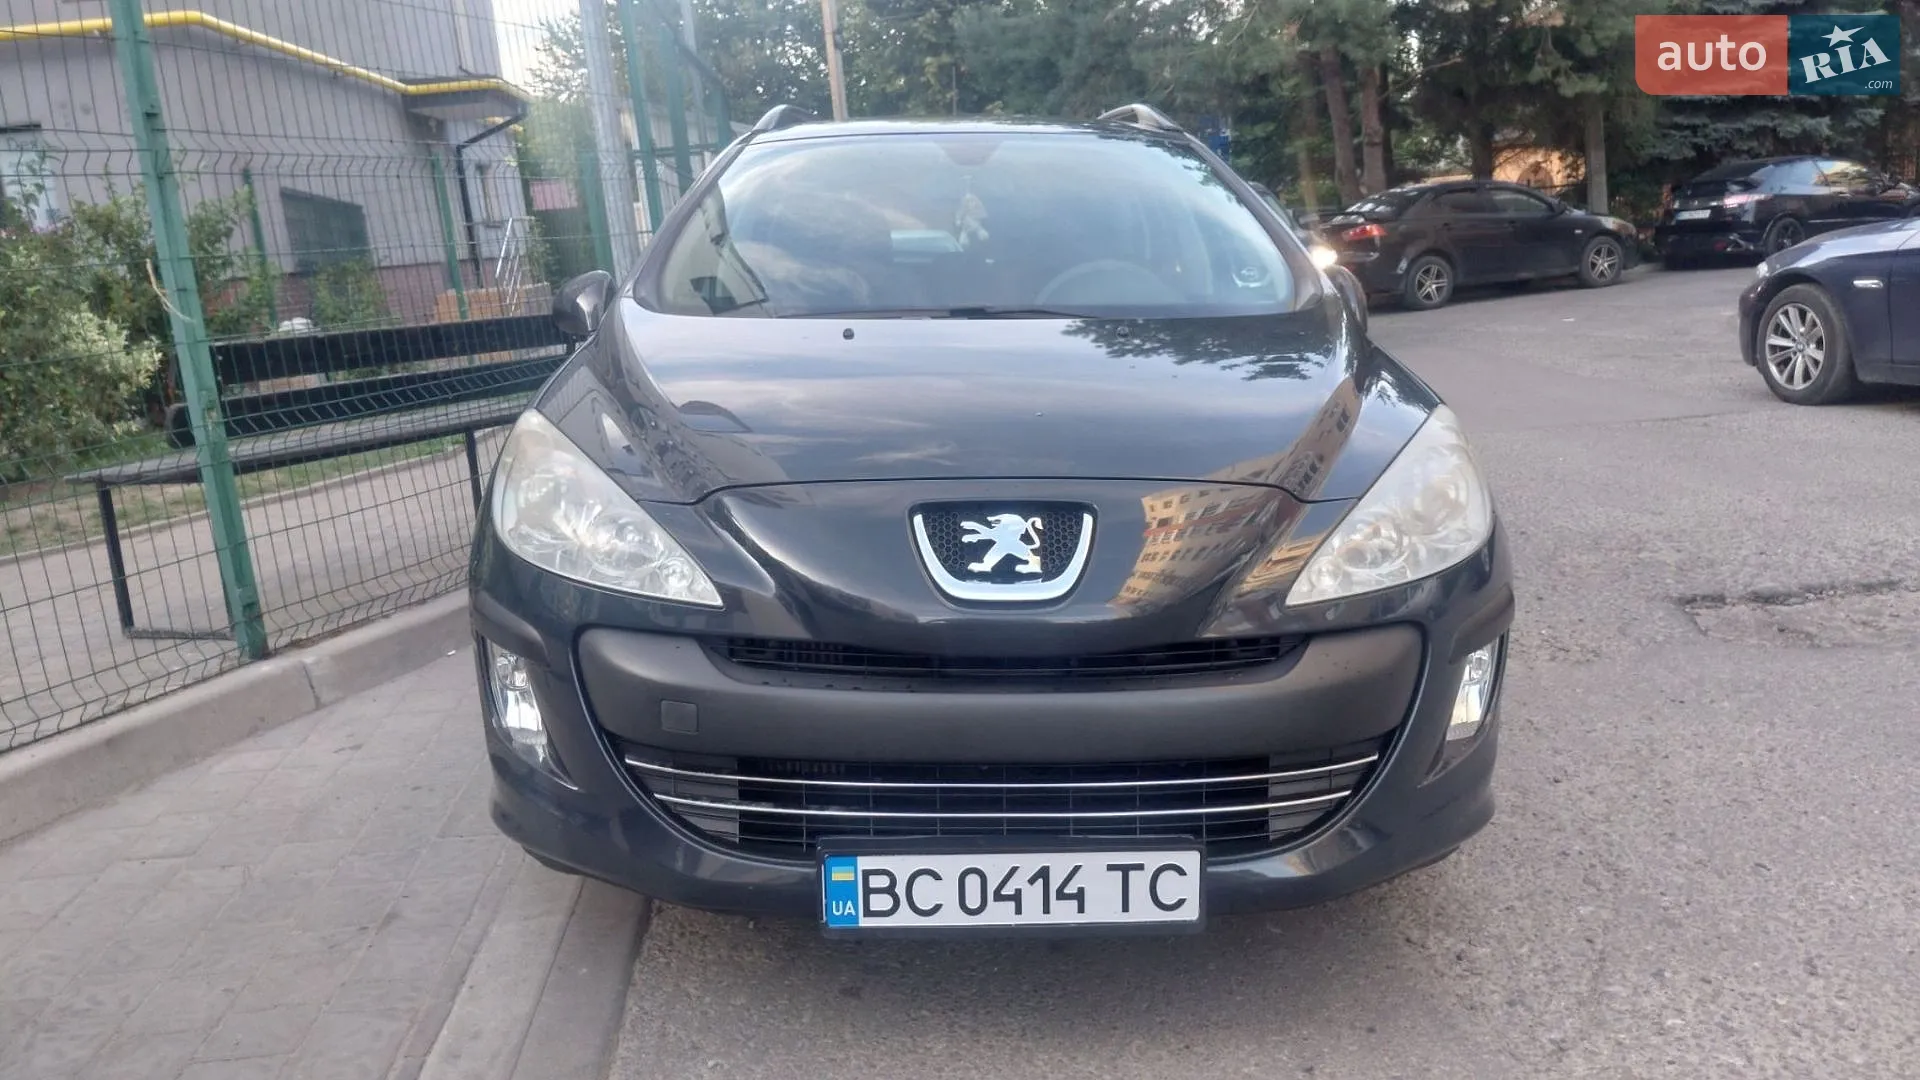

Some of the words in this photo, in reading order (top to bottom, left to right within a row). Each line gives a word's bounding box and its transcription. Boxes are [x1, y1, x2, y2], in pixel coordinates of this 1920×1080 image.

[861, 868, 943, 918] BC
[957, 864, 1086, 917] 0414
[1106, 862, 1188, 913] TC
[832, 901, 856, 916] UA
